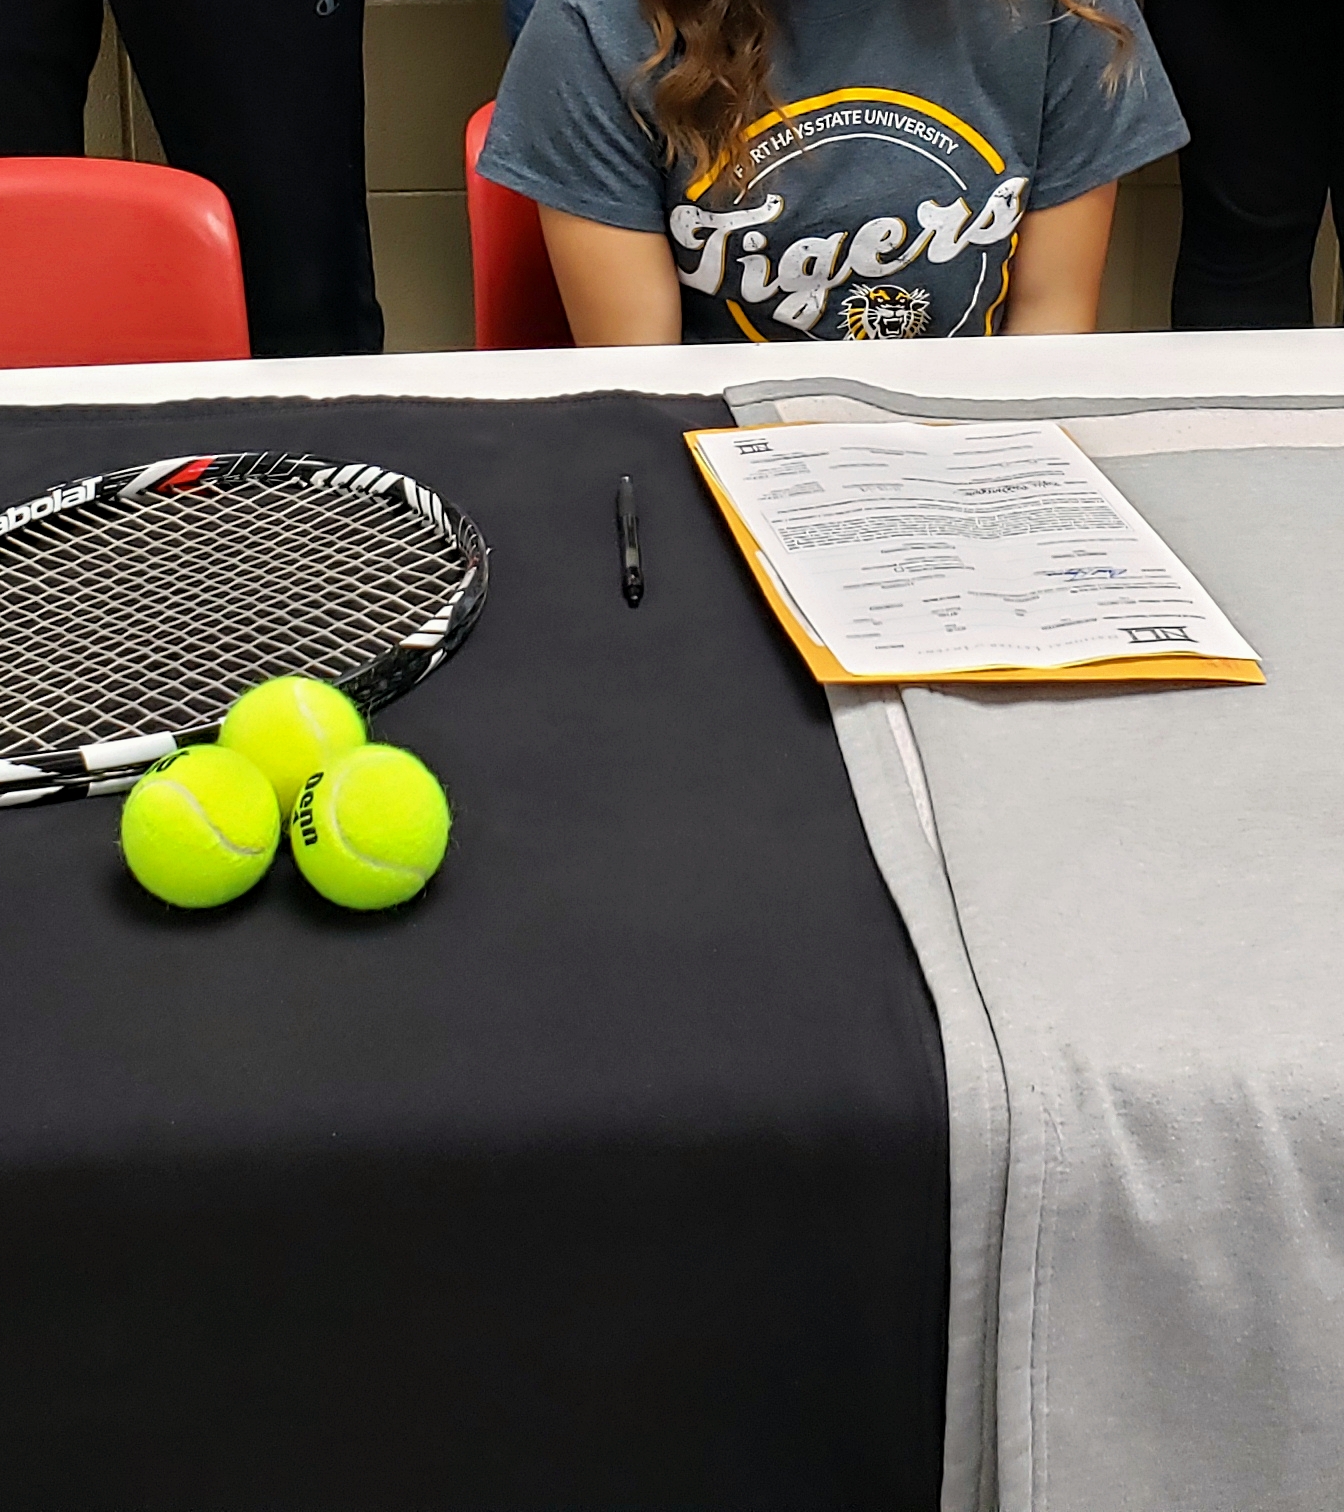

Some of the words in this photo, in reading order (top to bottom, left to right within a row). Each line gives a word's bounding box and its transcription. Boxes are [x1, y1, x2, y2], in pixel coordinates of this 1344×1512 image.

[734, 141, 773, 179] FRT
[771, 120, 816, 152] HAYS
[815, 108, 862, 133] STATE
[863, 108, 960, 156] UNIVERSITY
[669, 176, 1030, 332] Tigers
